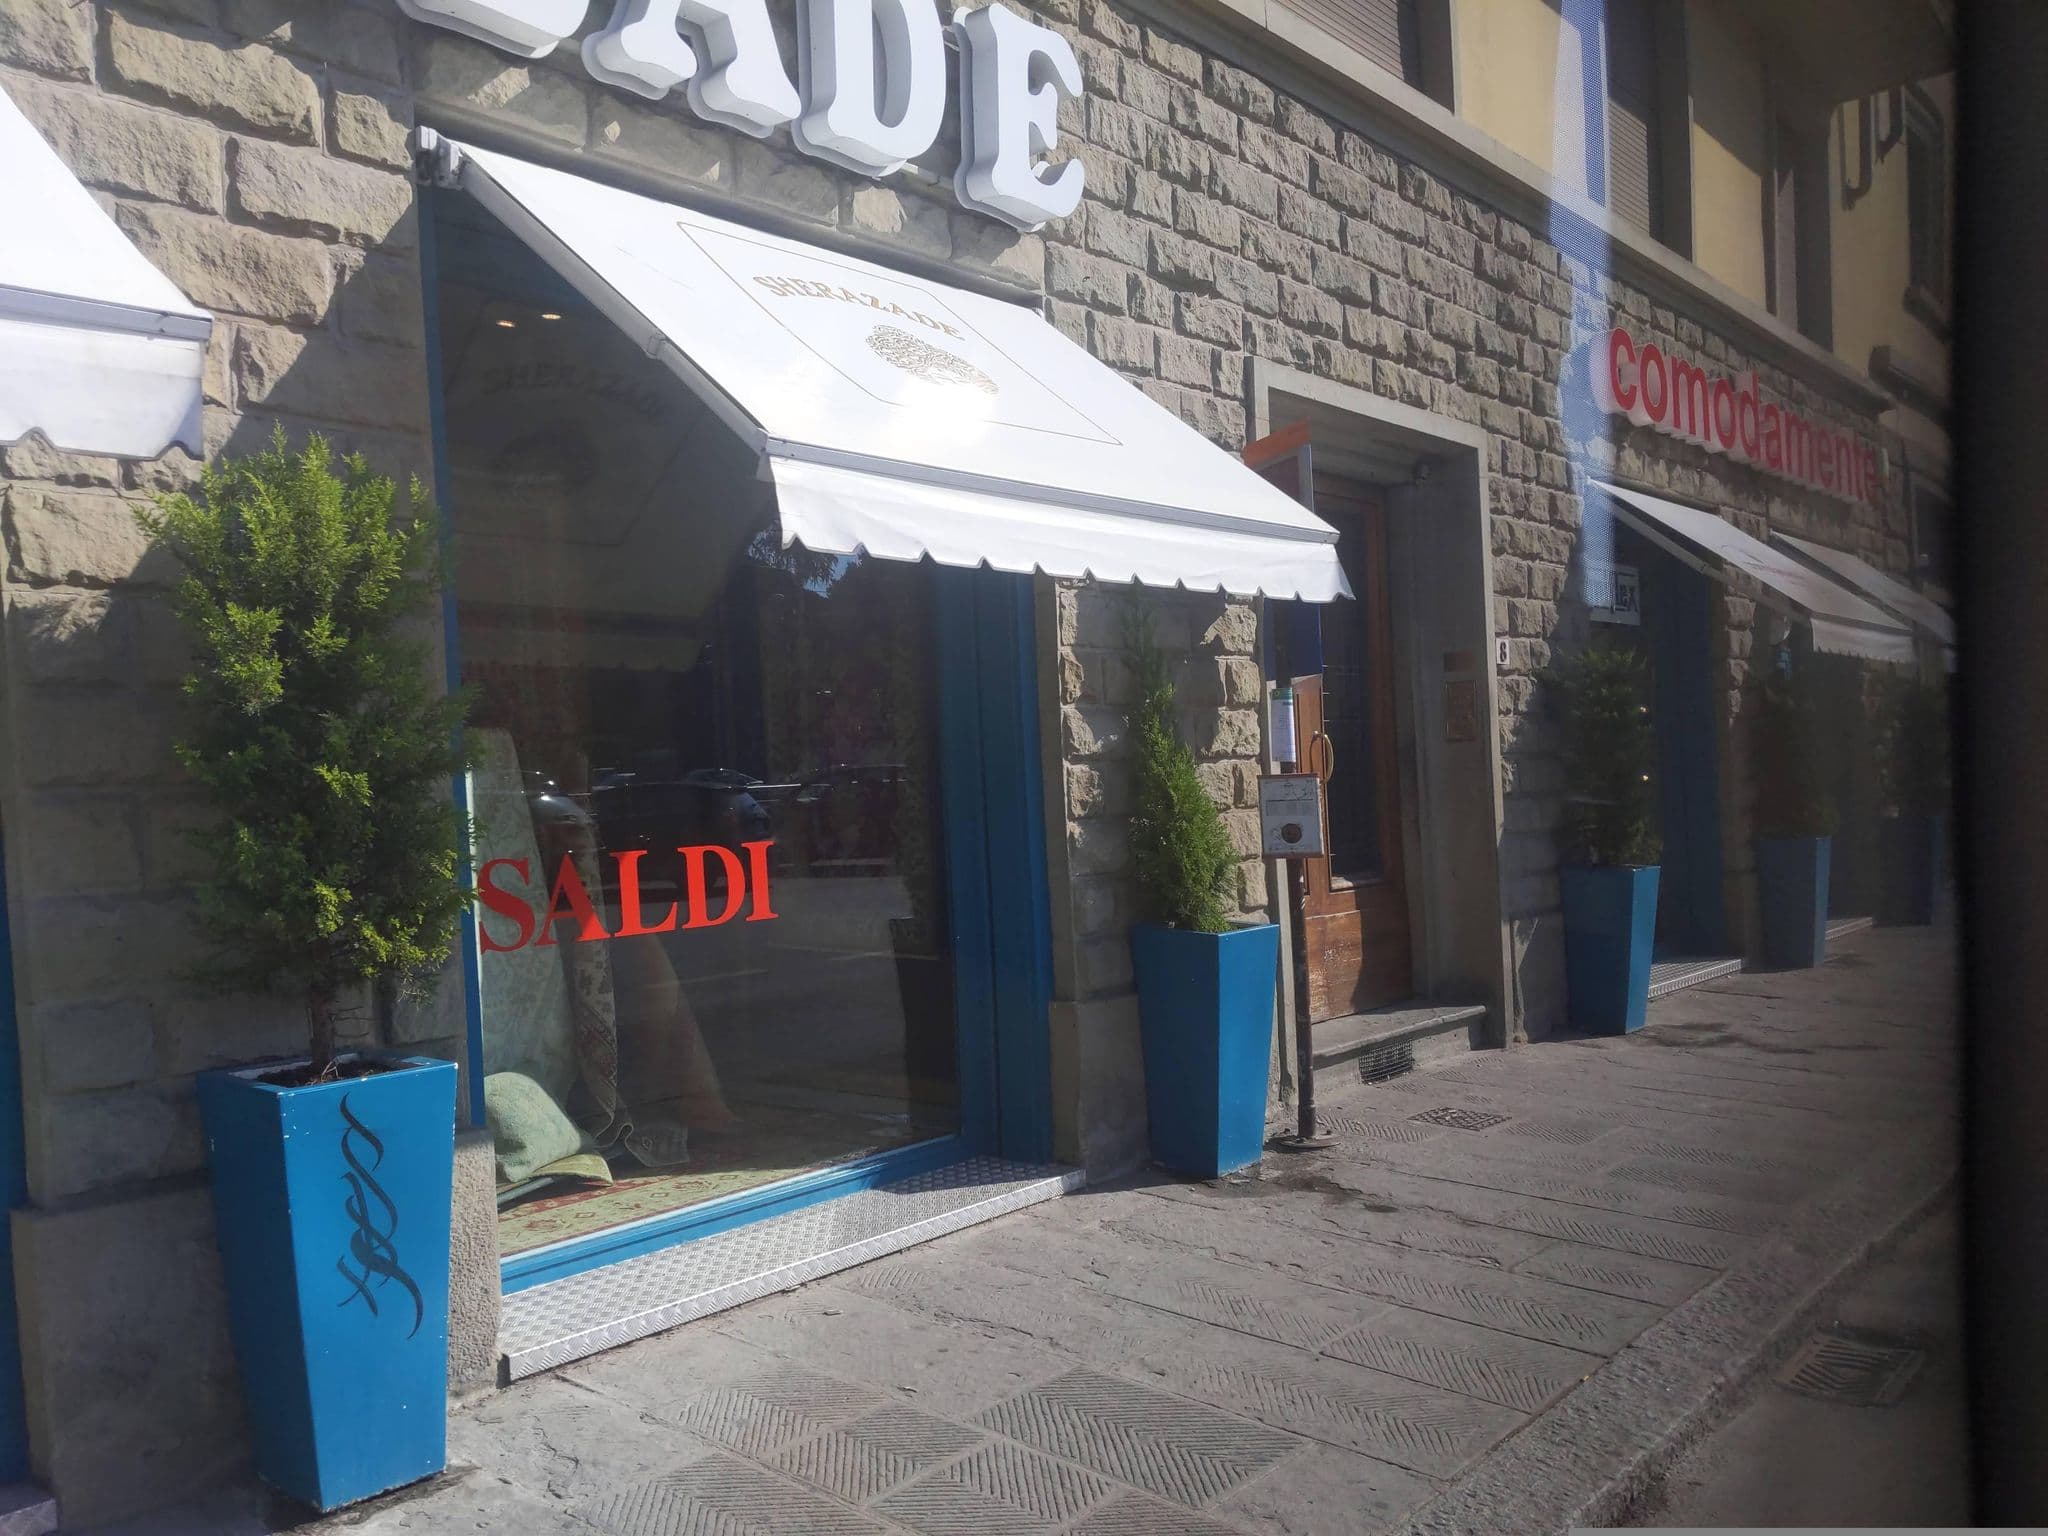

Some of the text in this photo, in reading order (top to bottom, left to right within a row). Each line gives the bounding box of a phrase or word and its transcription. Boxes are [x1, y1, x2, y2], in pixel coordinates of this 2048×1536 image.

[403, 0, 1085, 232] ADE
[752, 275, 966, 342] SHERAZADE
[1609, 327, 1879, 506] comodamente
[476, 840, 779, 955] SALDI
